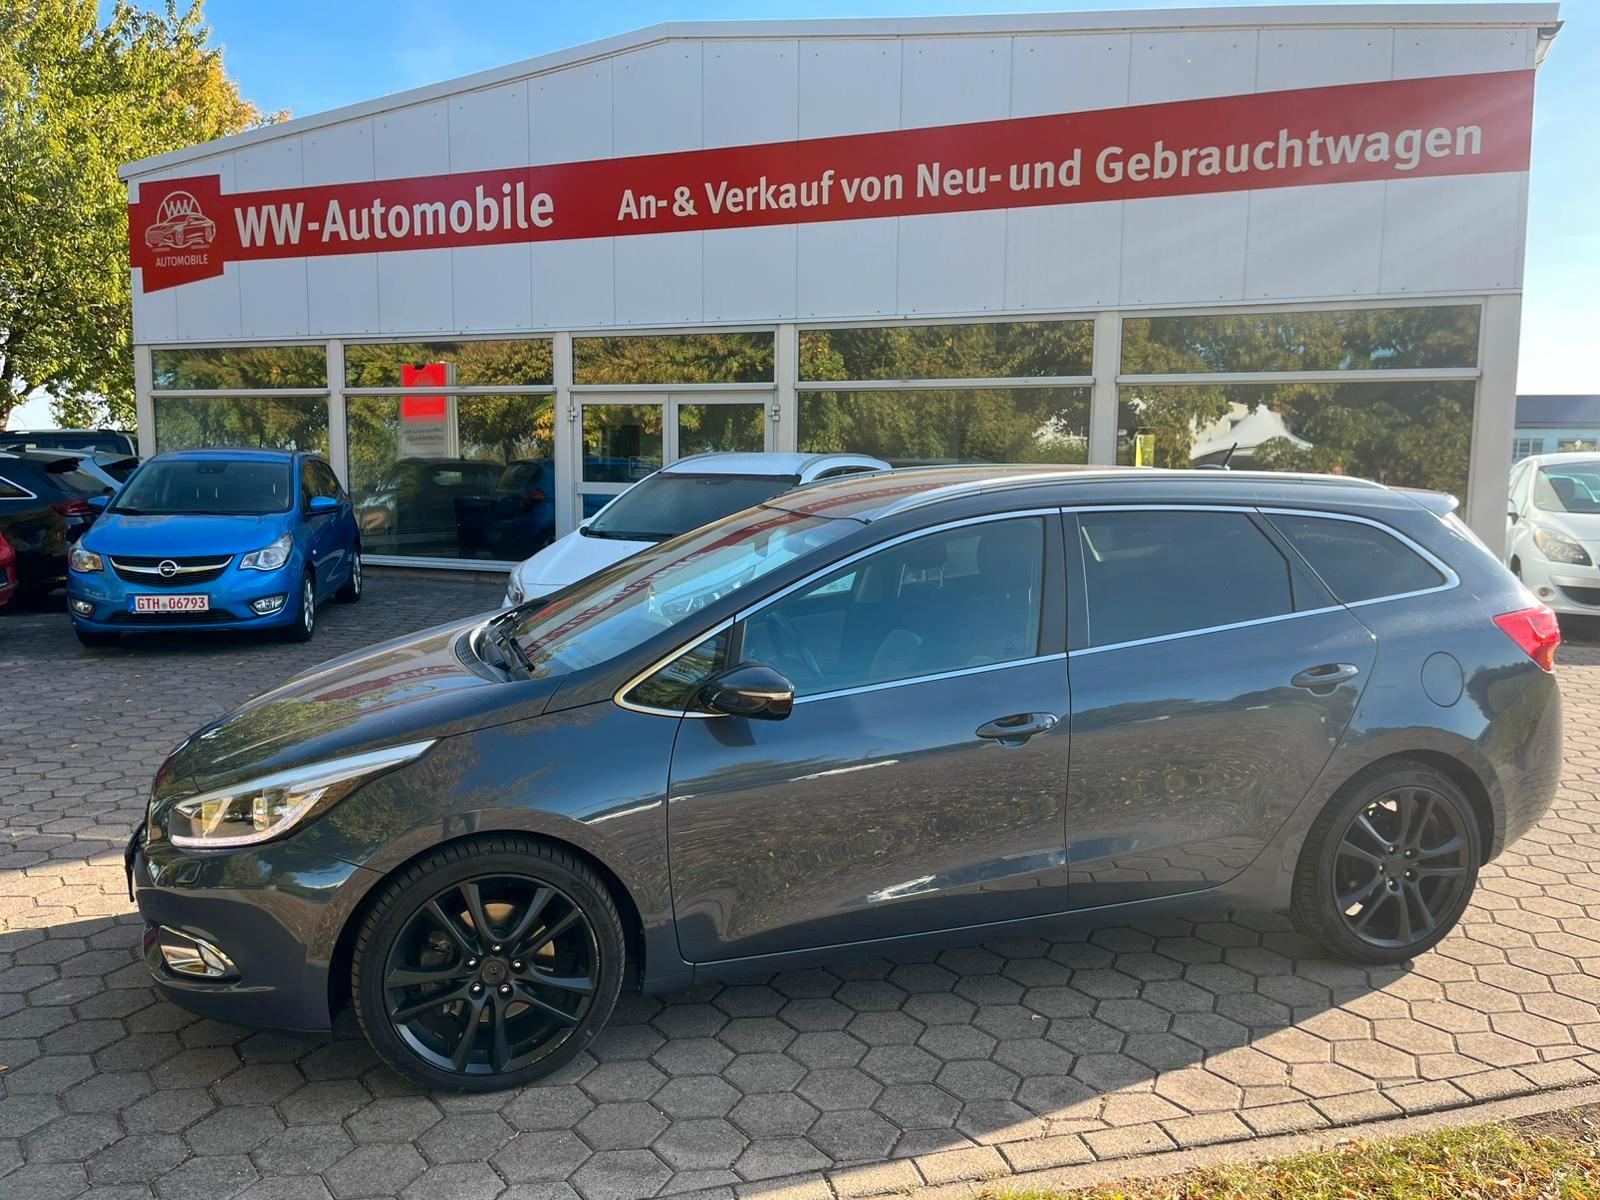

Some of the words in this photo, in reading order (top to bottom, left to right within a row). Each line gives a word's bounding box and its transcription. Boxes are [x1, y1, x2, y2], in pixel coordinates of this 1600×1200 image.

[704, 170, 835, 214] Verkauf
[840, 173, 904, 203] von
[1095, 123, 1483, 184] Gebrauchtwagen
[233, 182, 555, 248] WW-Automobile
[155, 253, 209, 268] AUTOMOBILE
[137, 598, 160, 609] GTH
[168, 597, 206, 609] 06793
